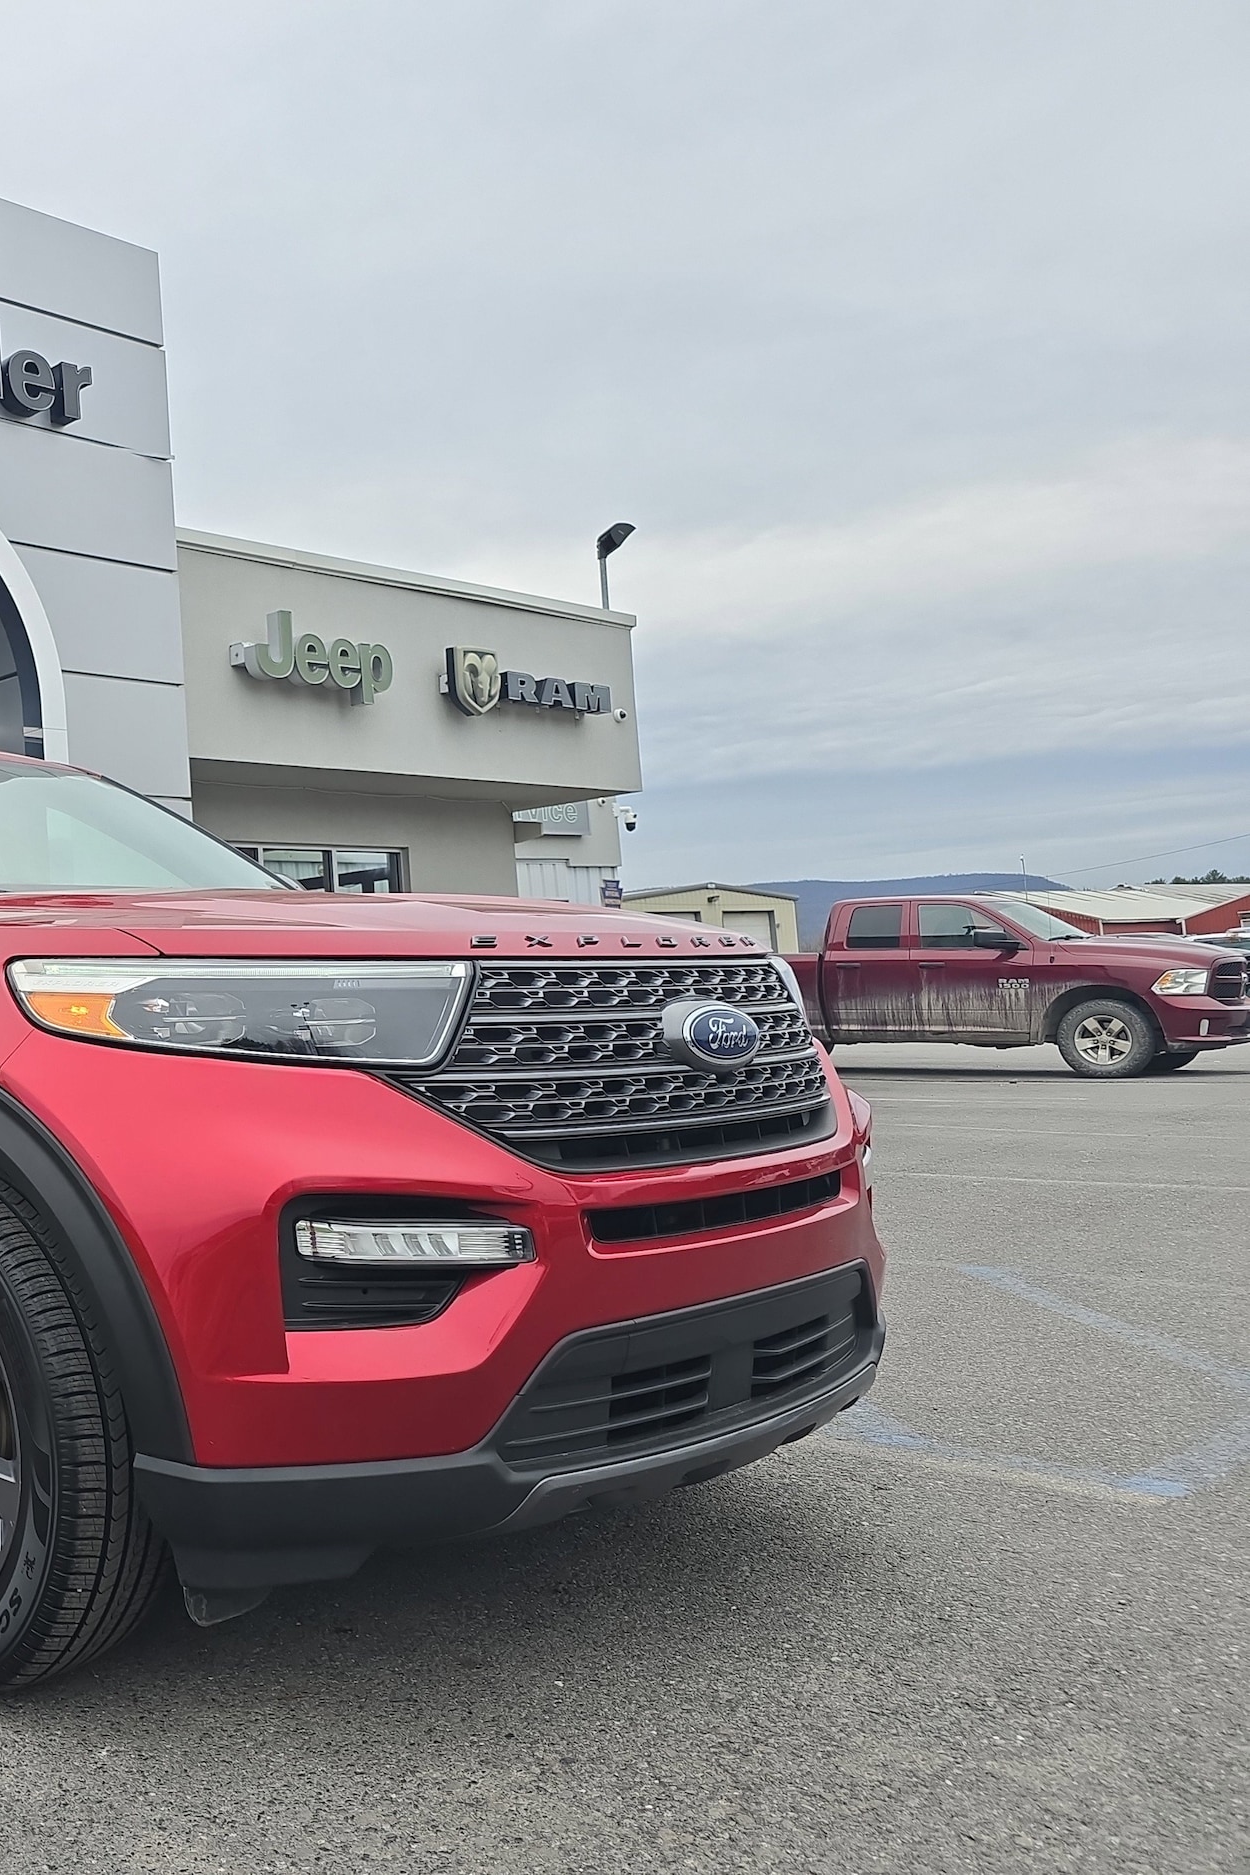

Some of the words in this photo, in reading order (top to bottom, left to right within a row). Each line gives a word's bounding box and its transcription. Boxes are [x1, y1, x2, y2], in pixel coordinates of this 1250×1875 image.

[246, 610, 393, 705] Jeep
[502, 670, 611, 714] RAM
[470, 934, 756, 948] EXPLORER
[707, 1017, 749, 1050] Ford
